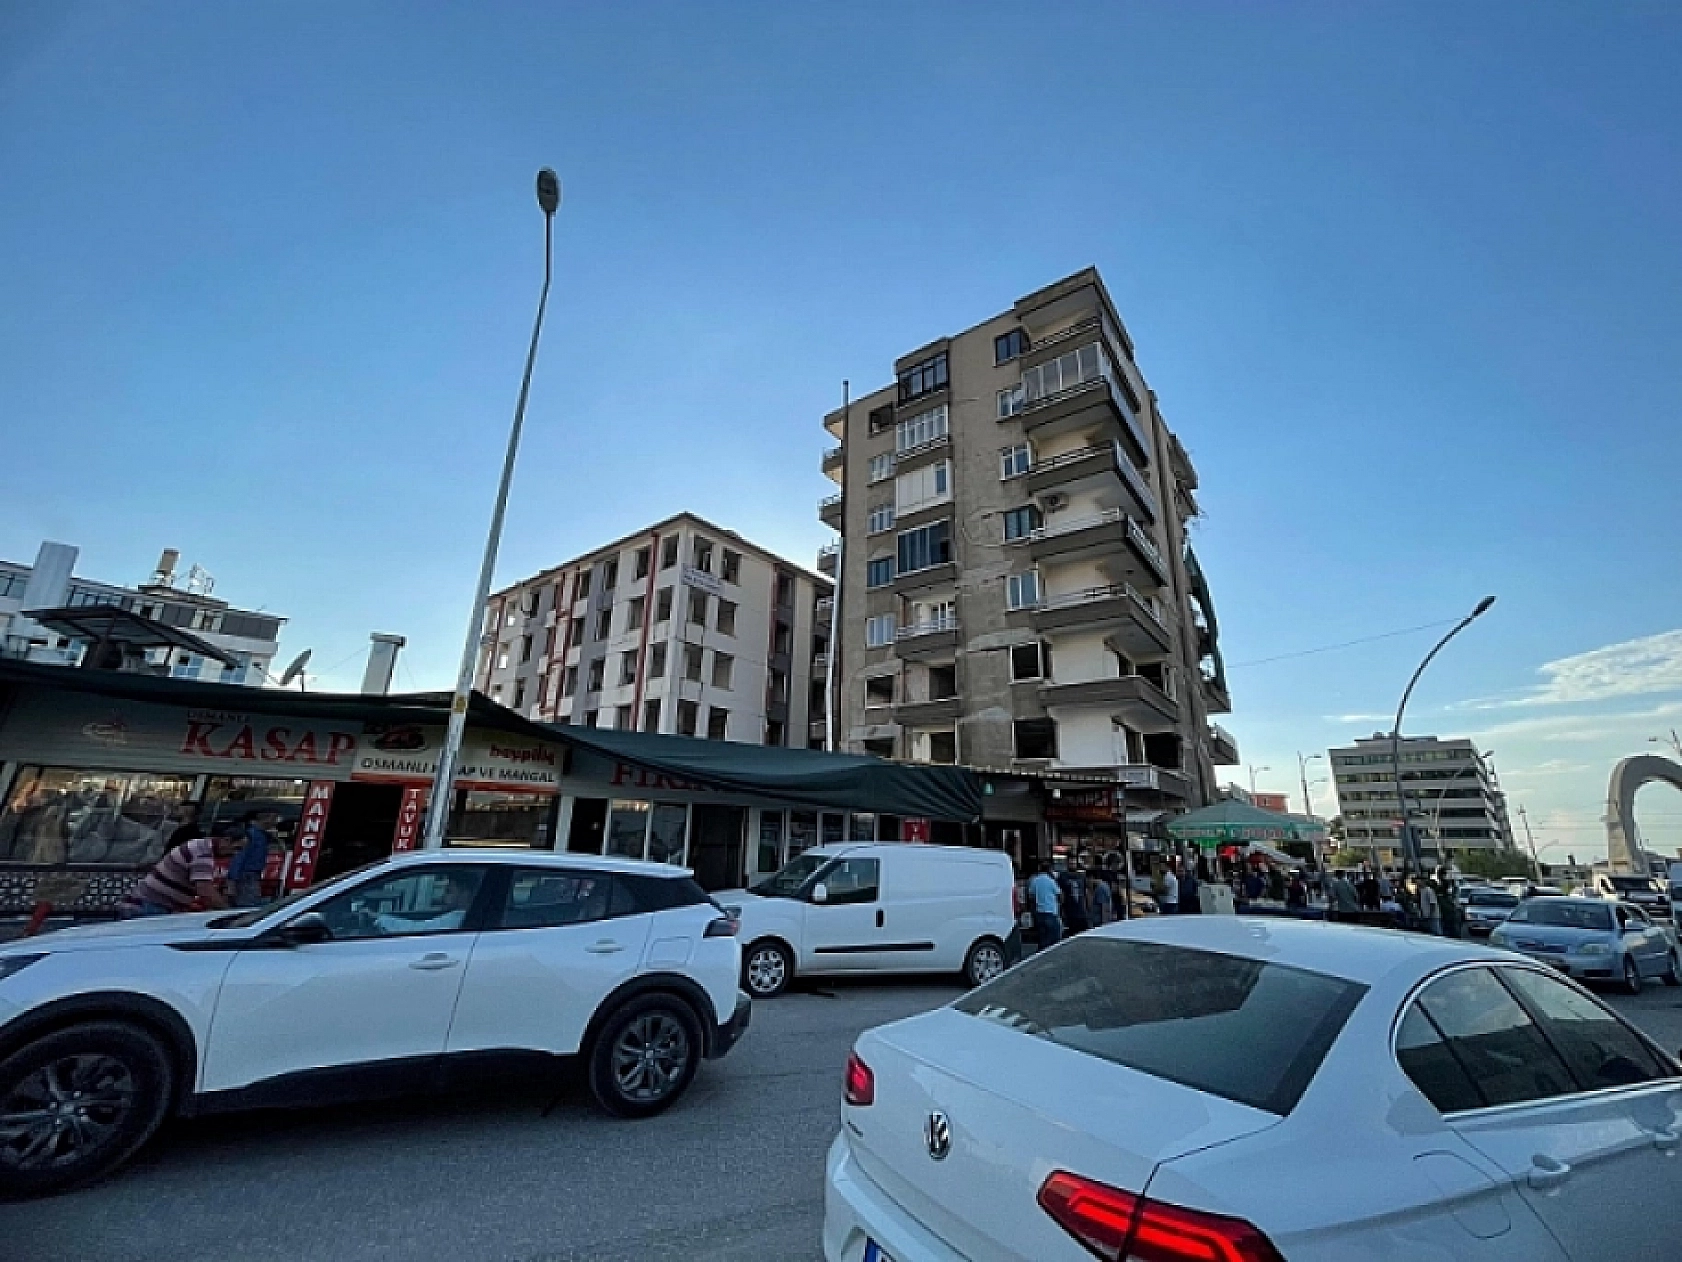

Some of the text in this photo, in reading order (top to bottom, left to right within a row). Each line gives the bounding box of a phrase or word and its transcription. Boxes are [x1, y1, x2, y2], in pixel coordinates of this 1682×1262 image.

[180, 721, 357, 765] KASAP
[361, 758, 429, 773] OSMANLI
[499, 768, 554, 783] MANGAL
[294, 786, 328, 882] MANGAL
[397, 788, 422, 849] TAVUK
